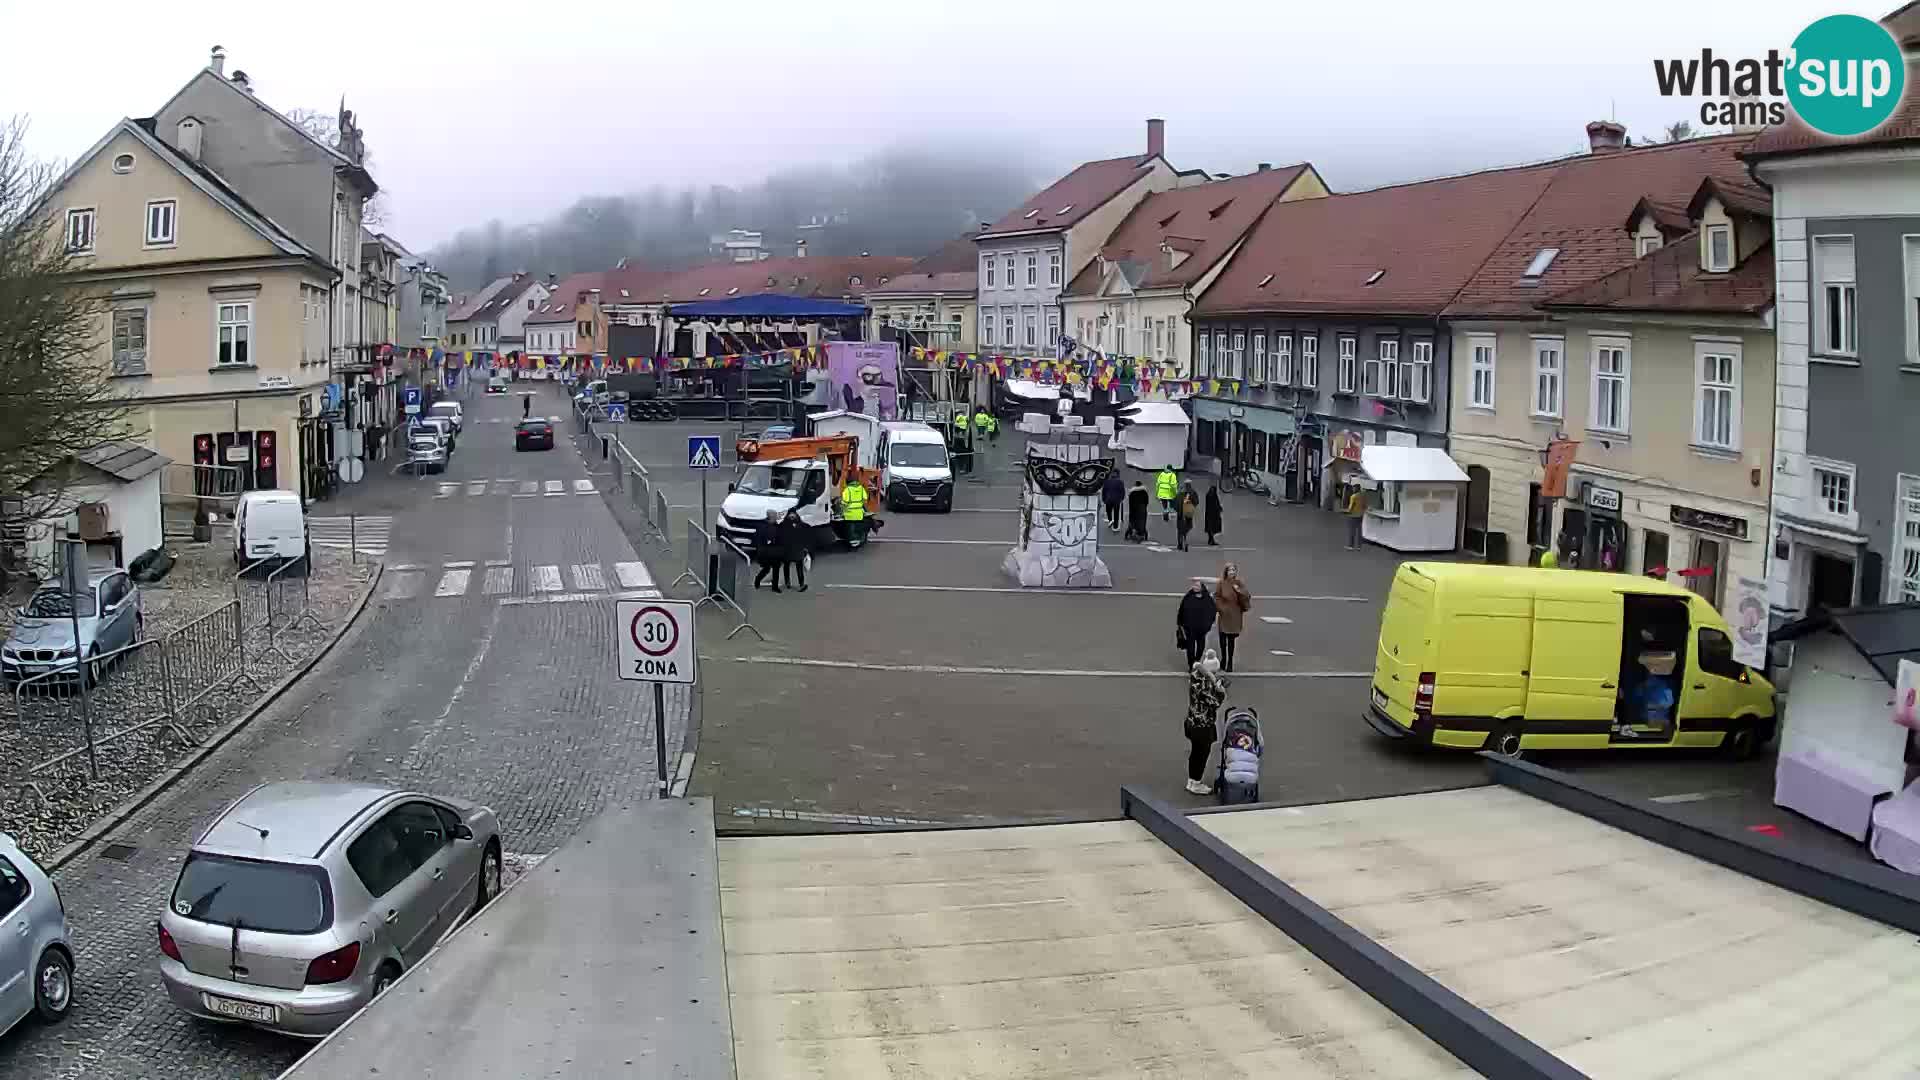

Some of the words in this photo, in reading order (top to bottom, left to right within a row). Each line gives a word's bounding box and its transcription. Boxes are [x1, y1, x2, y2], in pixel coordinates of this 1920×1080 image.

[408, 391, 416, 403] P
[1047, 516, 1087, 545] 200
[643, 622, 668, 643] 30
[633, 659, 678, 677] ZONA
